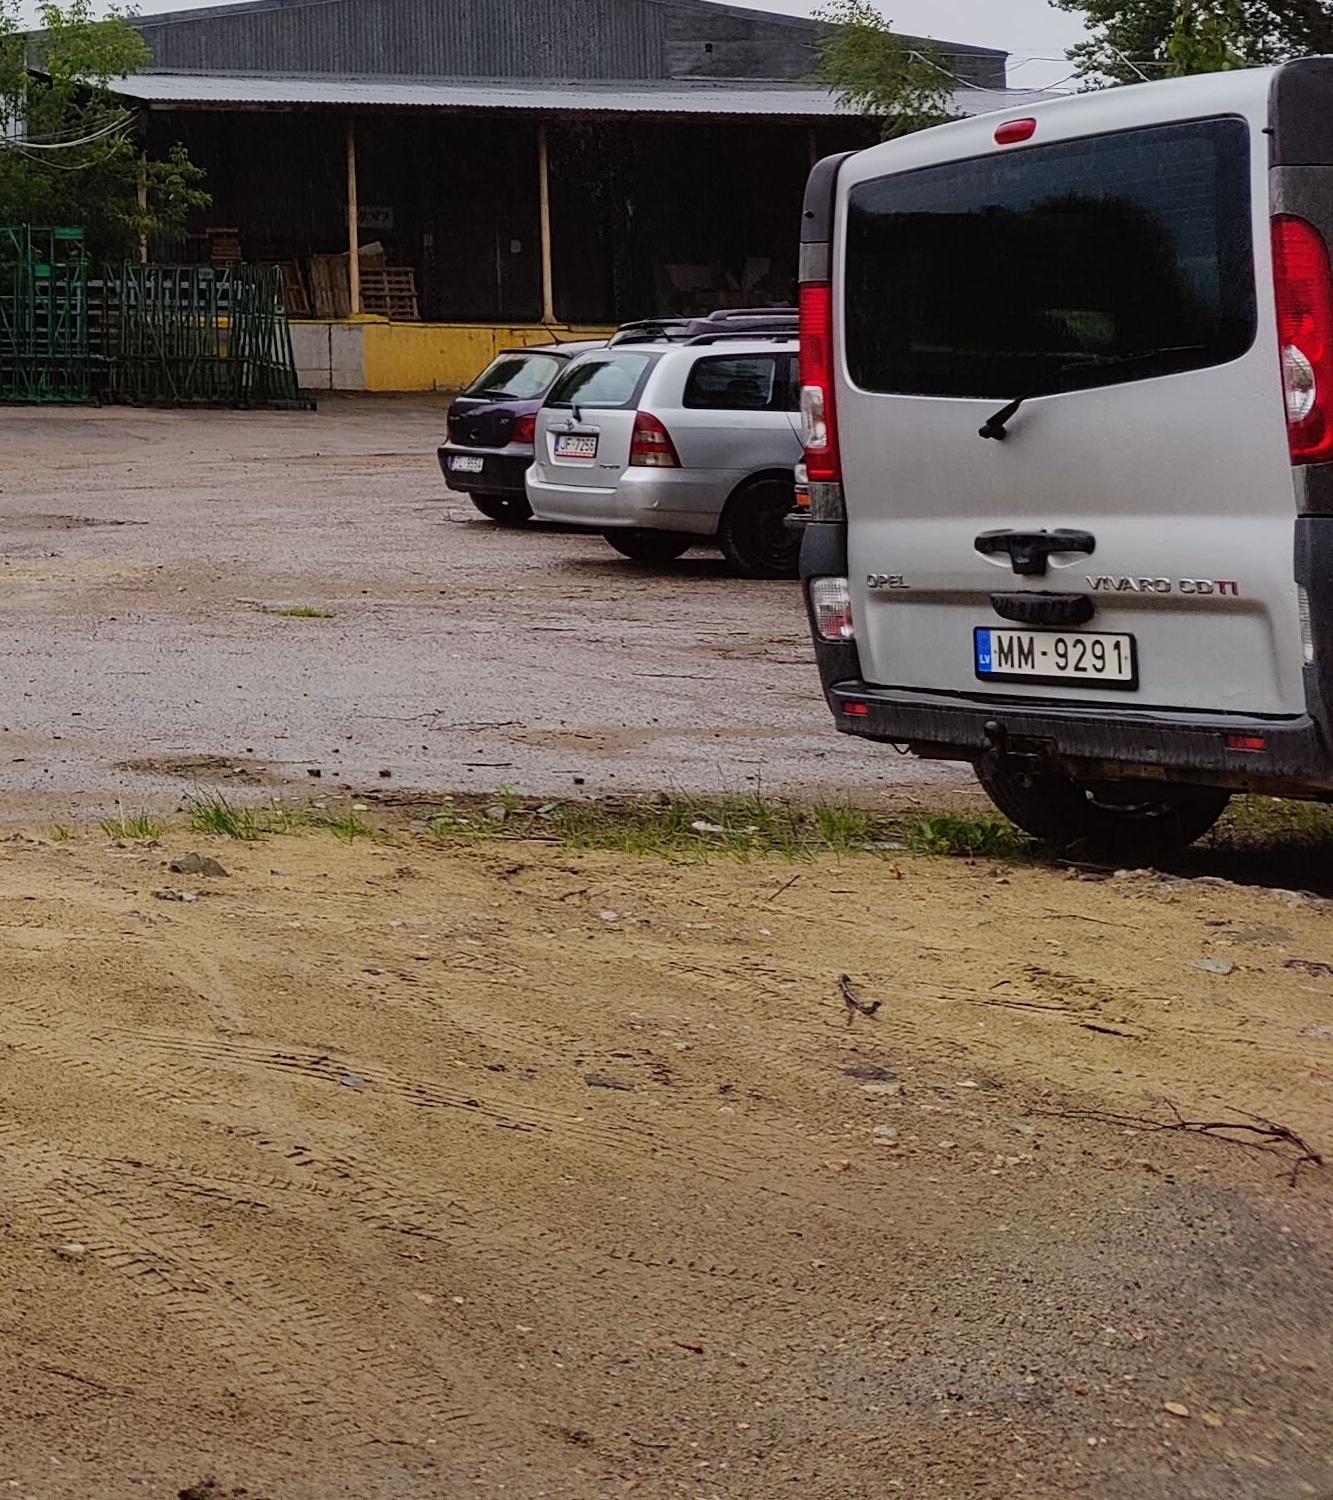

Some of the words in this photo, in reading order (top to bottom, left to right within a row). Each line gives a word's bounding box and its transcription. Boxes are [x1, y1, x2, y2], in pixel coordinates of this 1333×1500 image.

[866, 573, 909, 588] OPEL
[1085, 575, 1171, 593] VIVARO
[1179, 578, 1238, 596] CDTI
[979, 654, 990, 664] LV
[997, 635, 1122, 674] MM-9291
